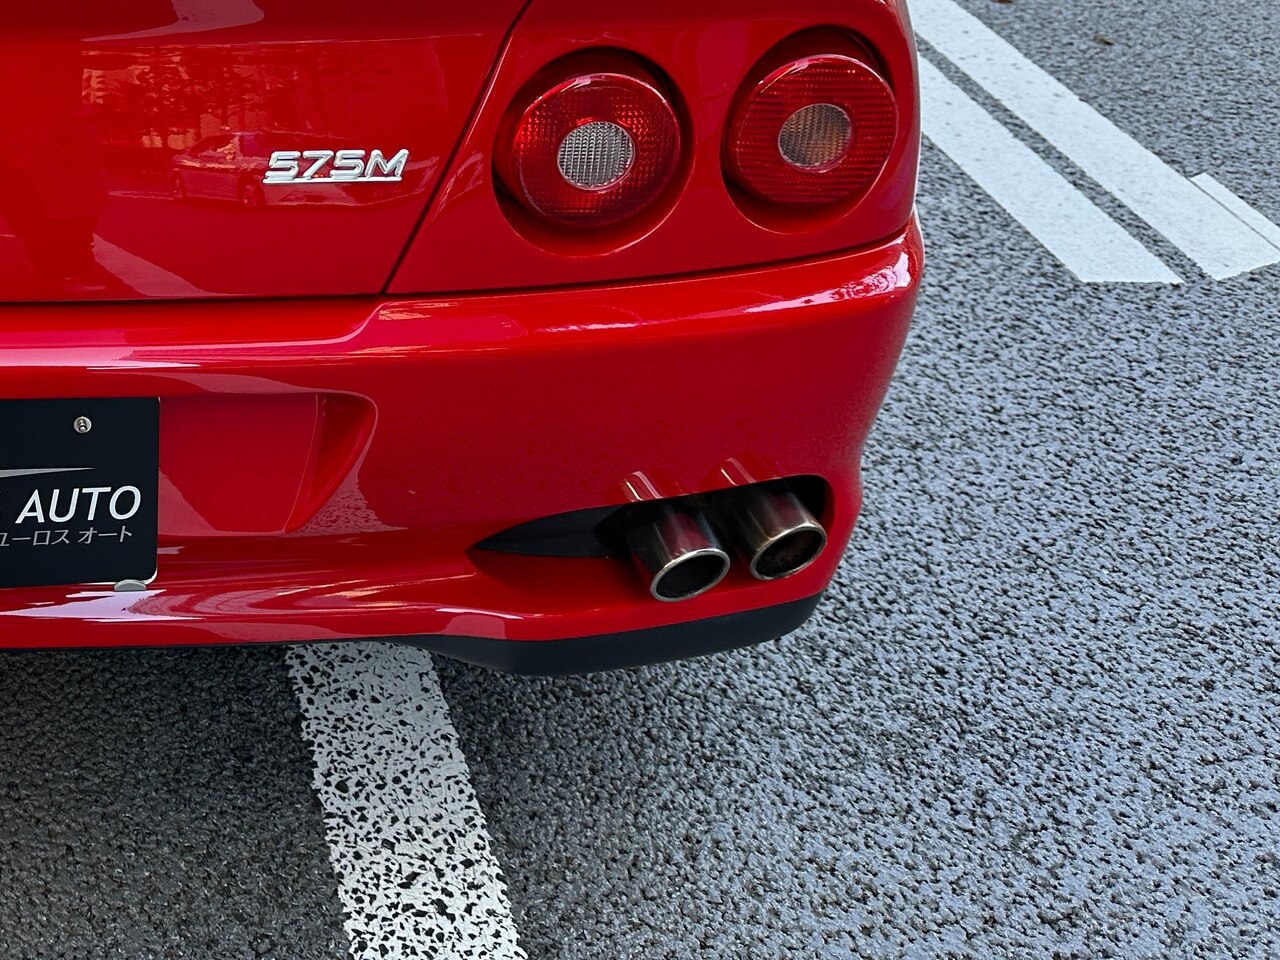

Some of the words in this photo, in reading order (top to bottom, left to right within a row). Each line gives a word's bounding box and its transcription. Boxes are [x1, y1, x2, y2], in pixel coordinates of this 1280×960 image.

[264, 149, 410, 182] 575M
[14, 485, 142, 524] AUTO
[77, 525, 133, 545] オート
